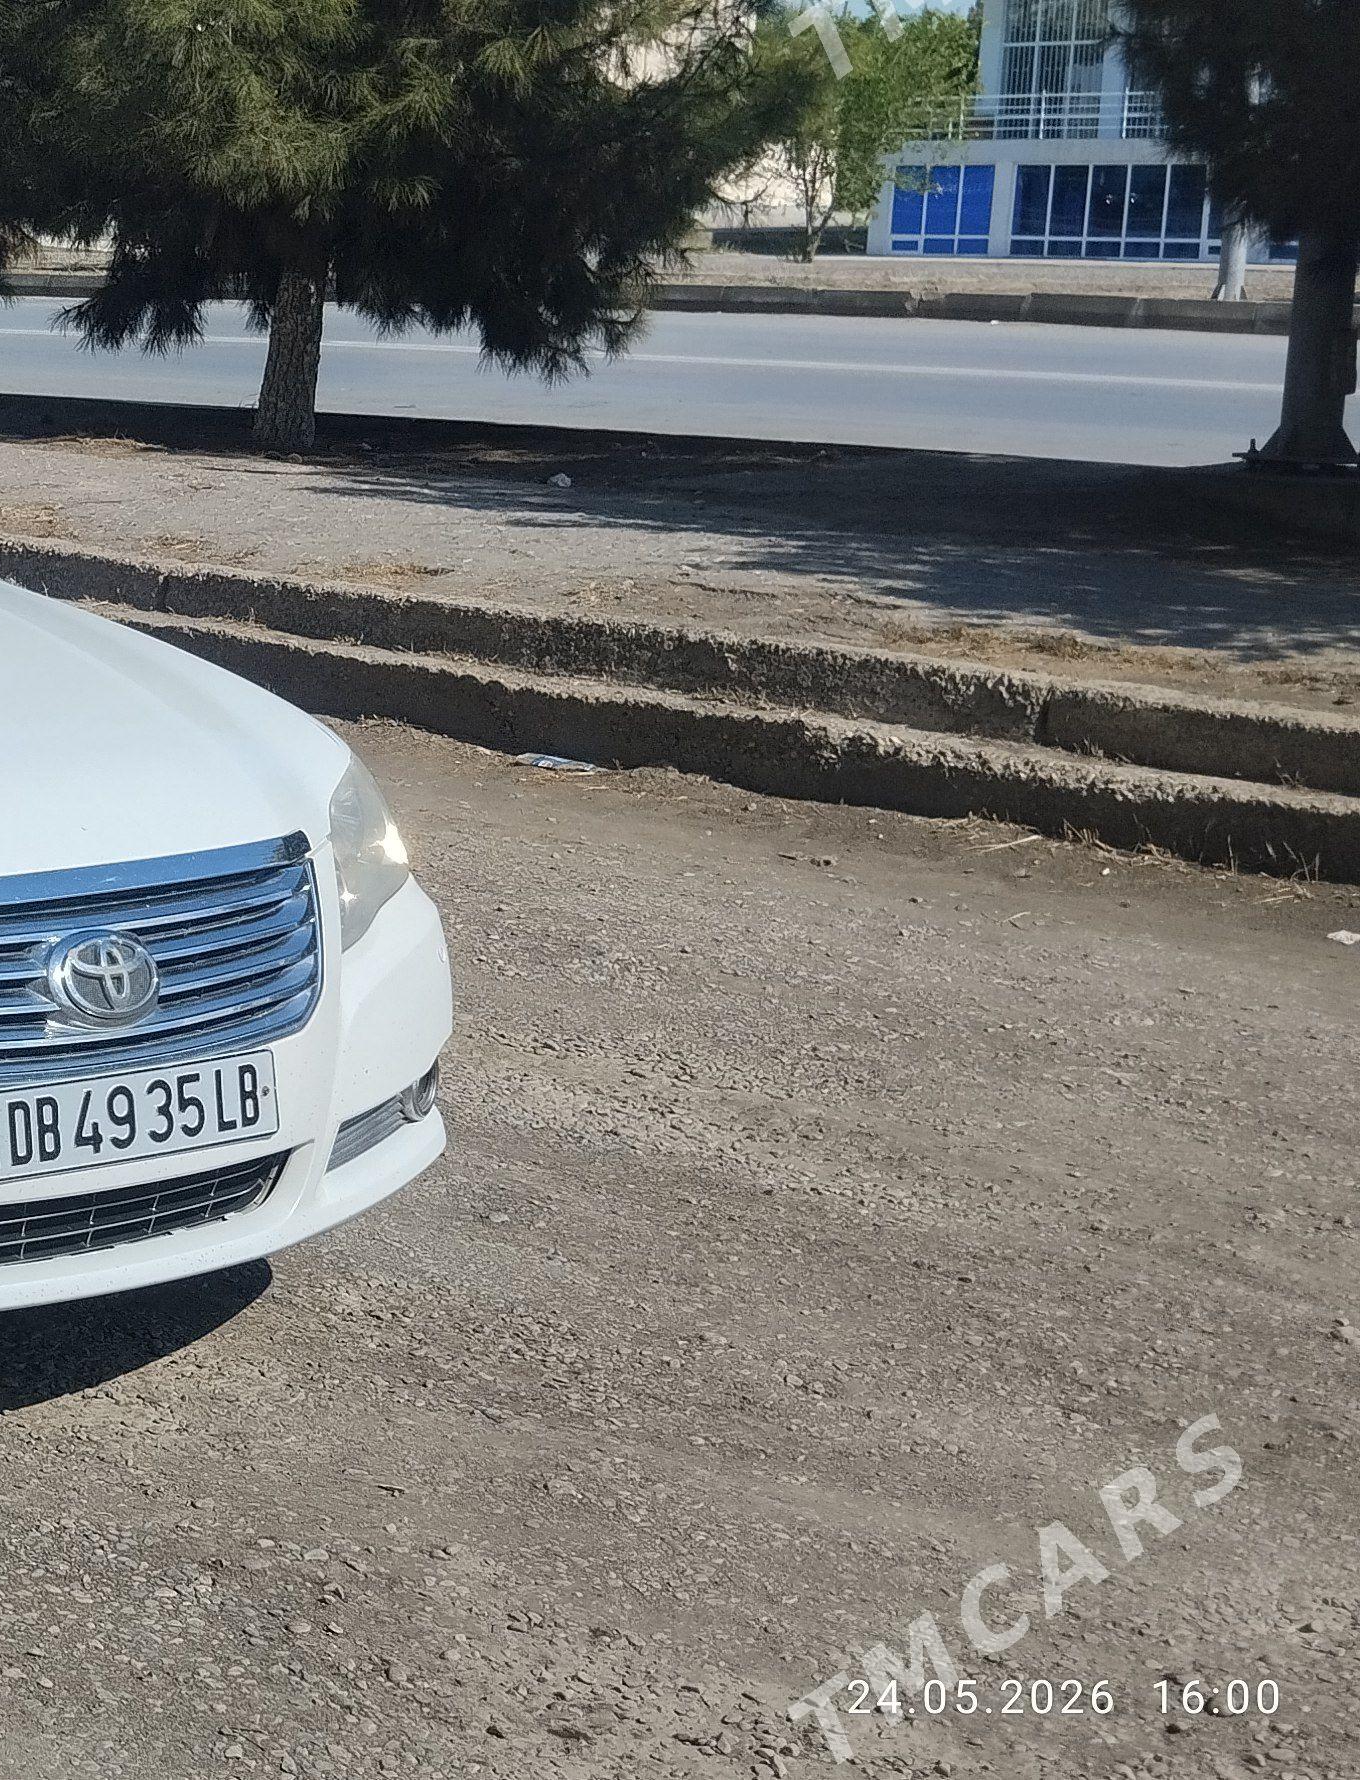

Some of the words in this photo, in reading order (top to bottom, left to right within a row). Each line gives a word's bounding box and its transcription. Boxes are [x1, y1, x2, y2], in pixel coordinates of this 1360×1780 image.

[7, 1095, 61, 1166] DB
[74, 1085, 136, 1153] 49
[145, 1073, 205, 1143] 35
[214, 1063, 260, 1132] LB
